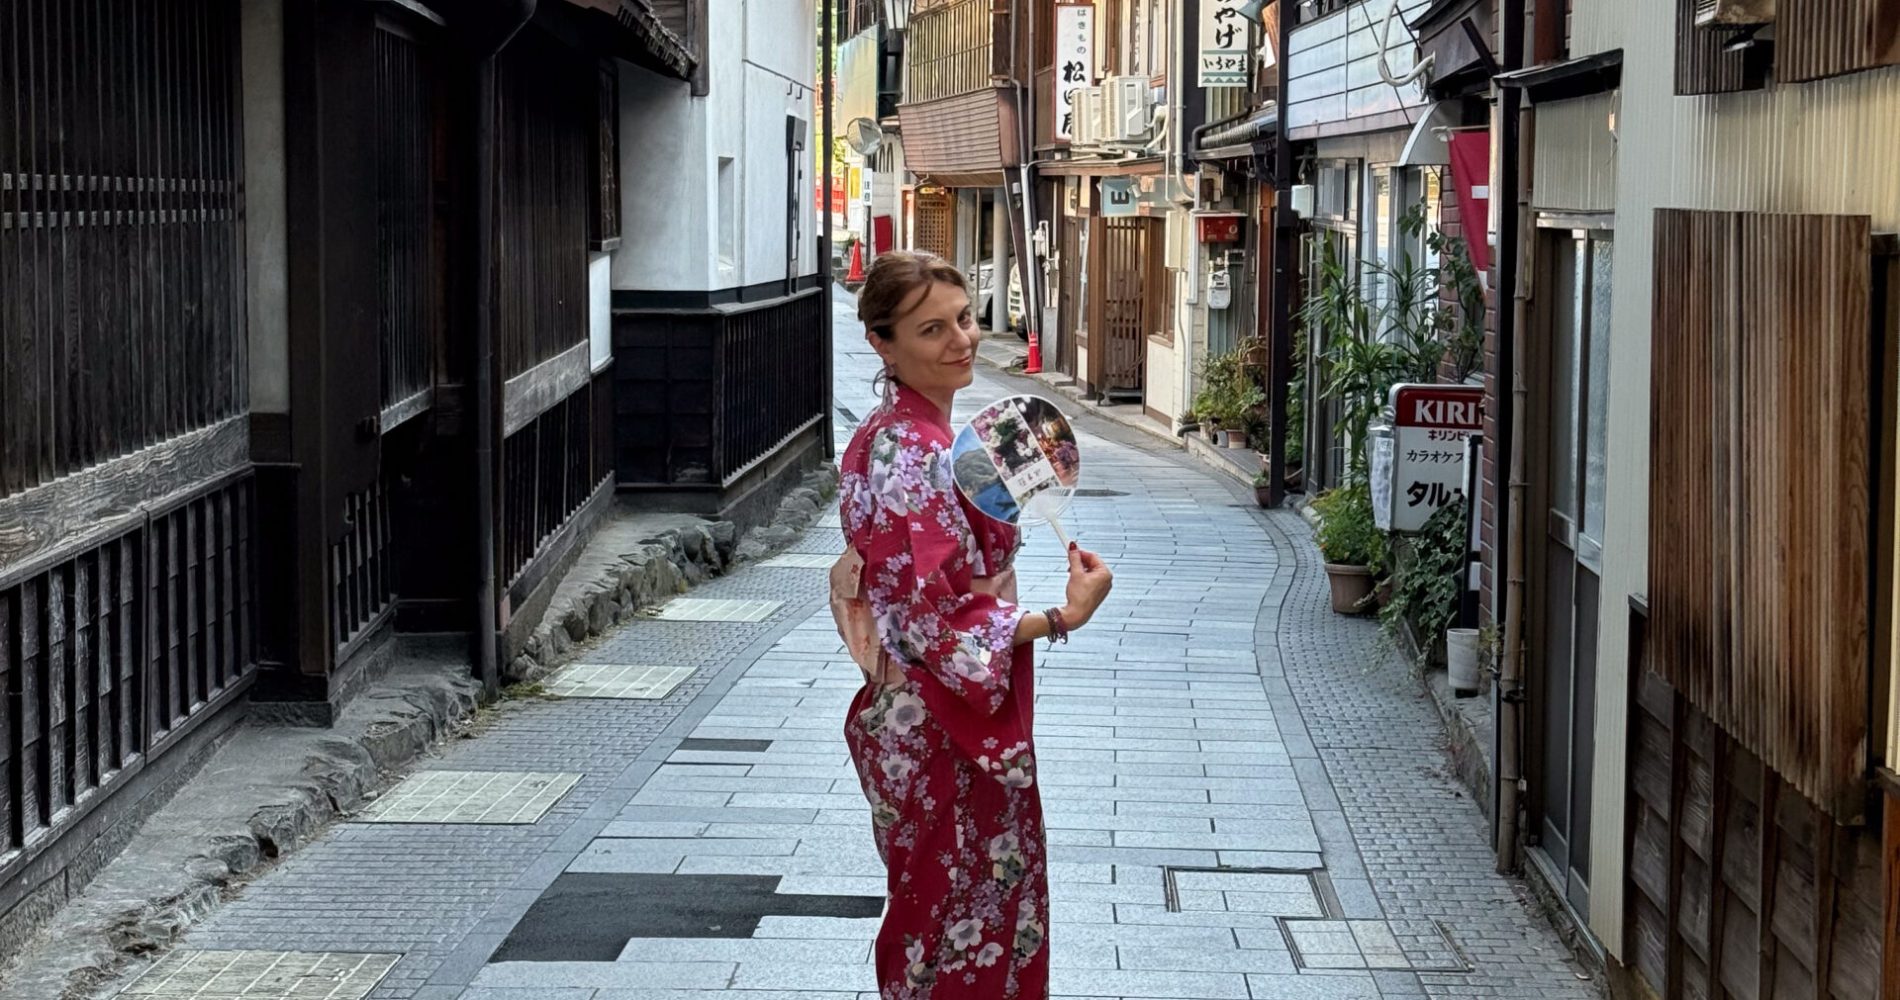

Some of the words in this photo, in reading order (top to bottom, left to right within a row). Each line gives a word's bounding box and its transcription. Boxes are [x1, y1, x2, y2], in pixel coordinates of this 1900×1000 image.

[1077, 9, 1087, 55] はきもの
[1214, 0, 1242, 49] やげ
[1203, 54, 1246, 72] いちやま
[1414, 399, 1482, 426] KIRI
